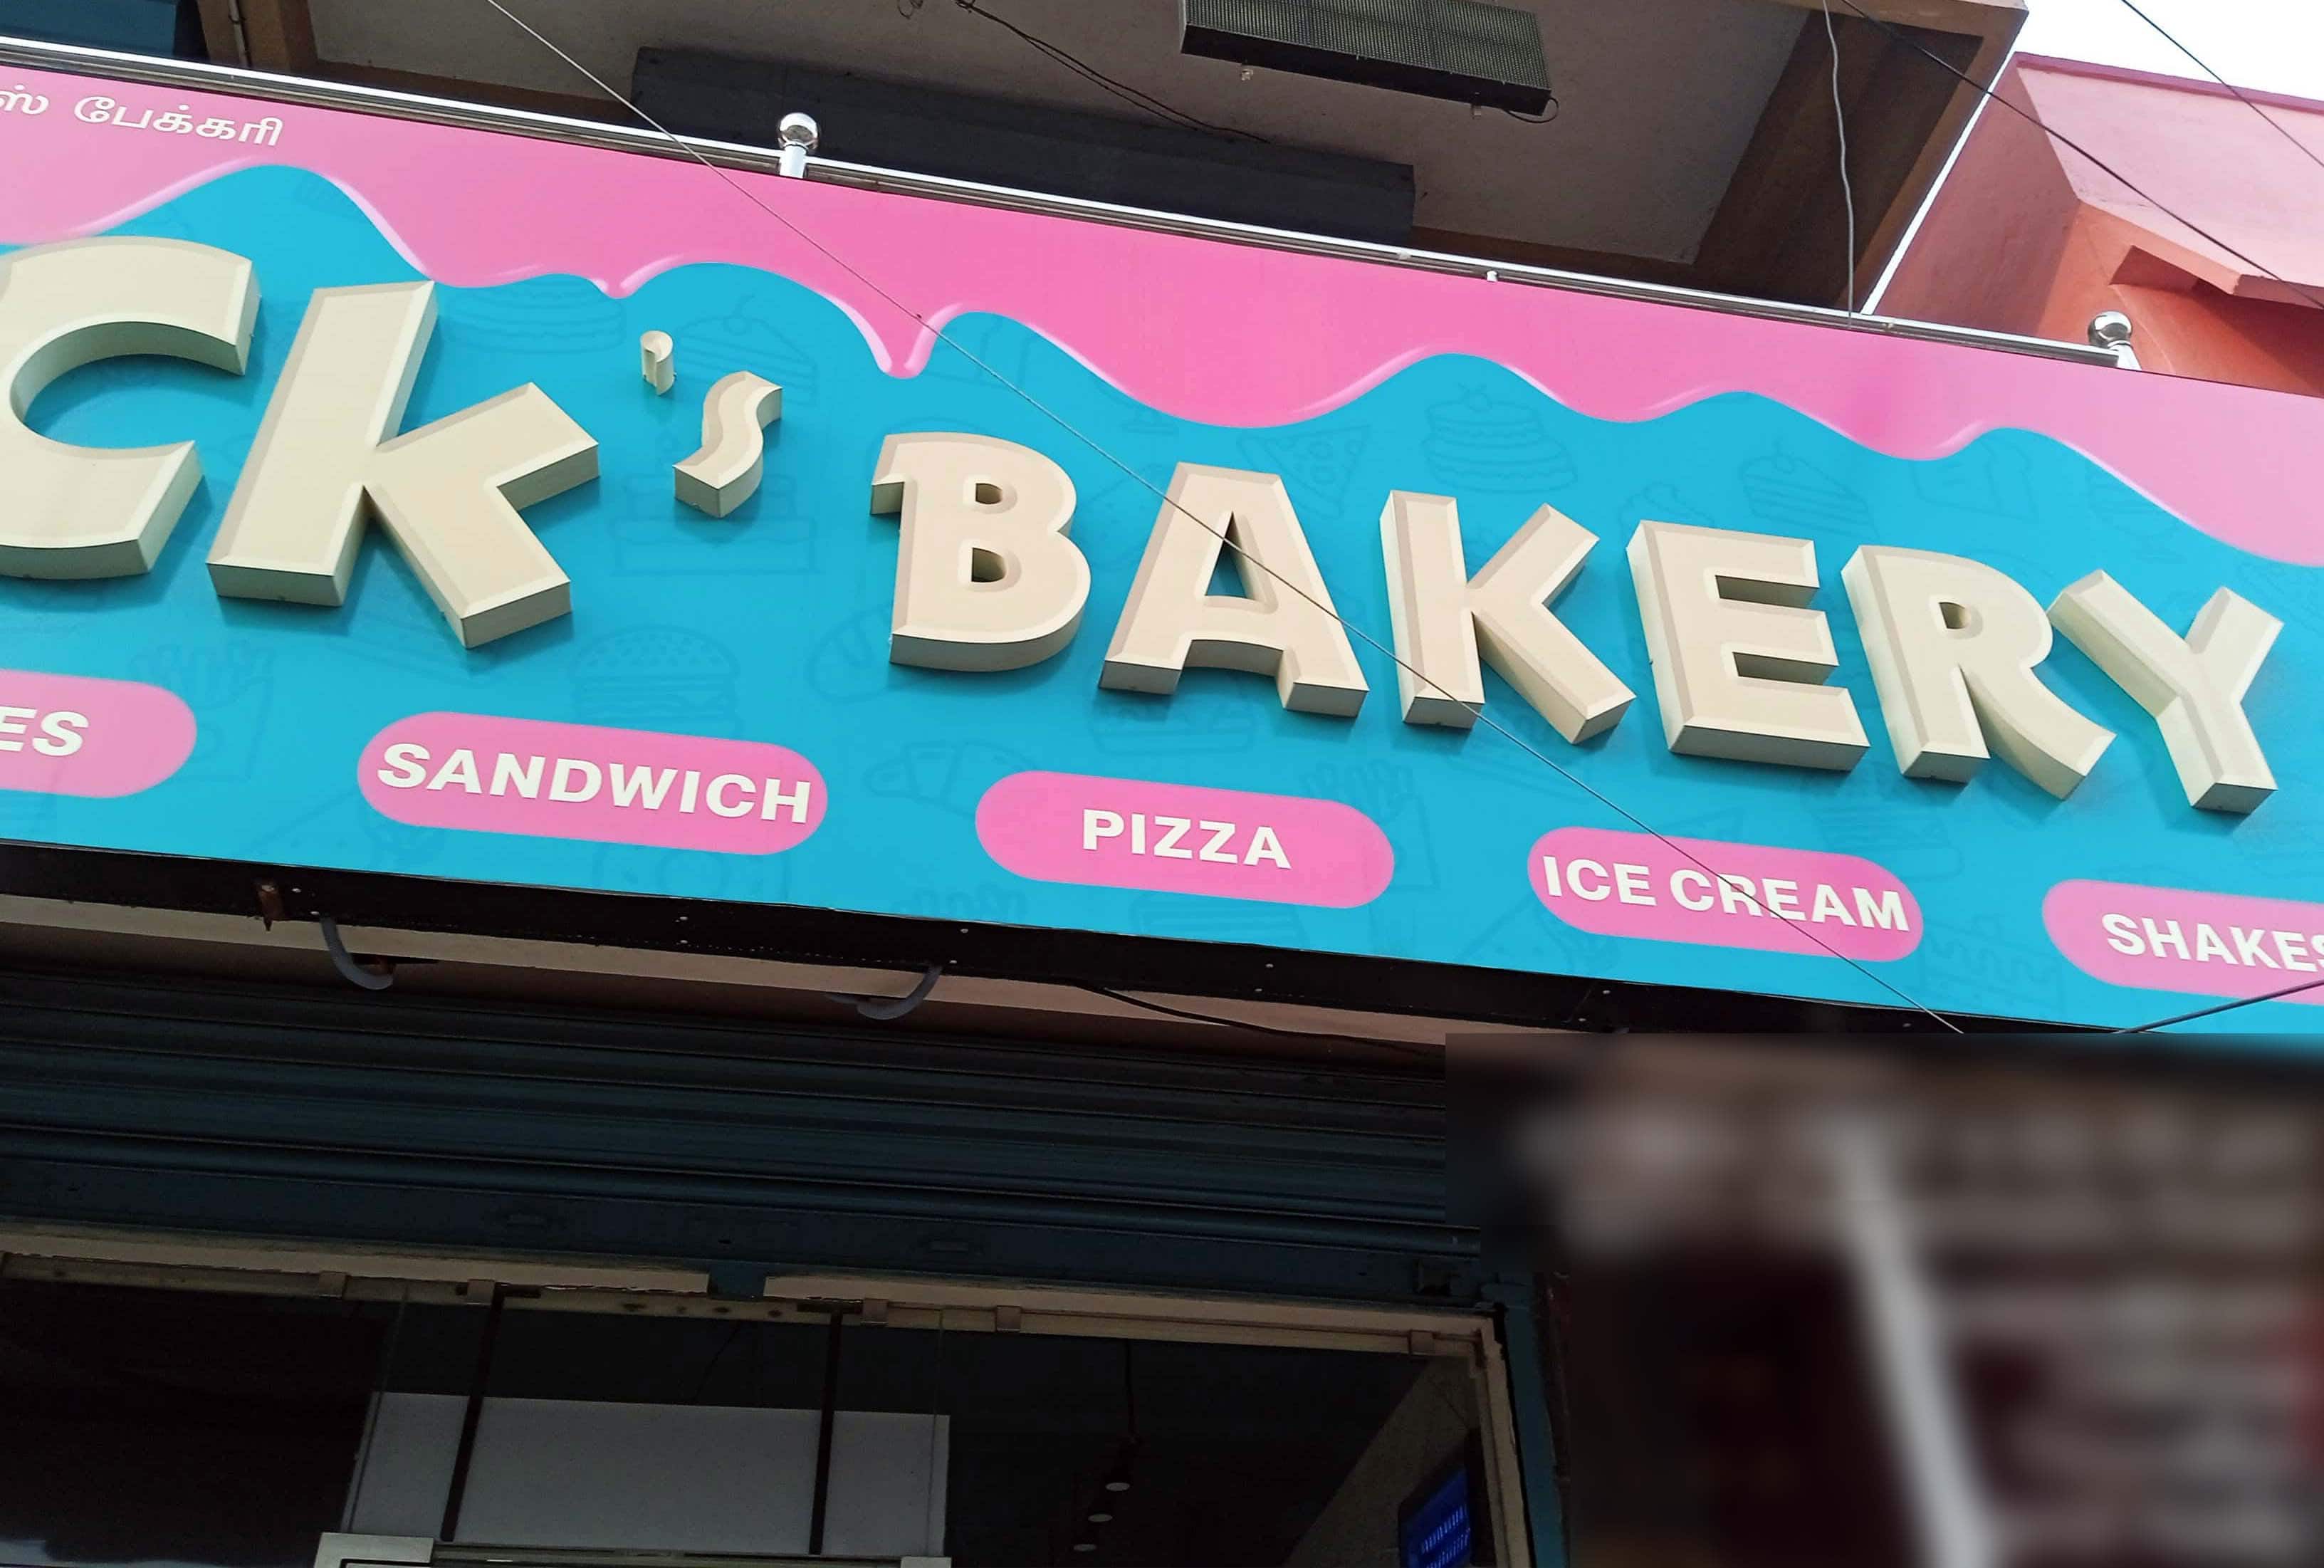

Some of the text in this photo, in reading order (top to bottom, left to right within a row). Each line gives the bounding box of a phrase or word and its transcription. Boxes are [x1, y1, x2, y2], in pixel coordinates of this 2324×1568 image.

[74, 95, 283, 147] பேக்கரி
[870, 431, 2285, 815] BAKERY
[377, 742, 811, 823] SANDWICH
[1082, 808, 1292, 869] PIZZA
[1541, 855, 1910, 932] ICE CREAM
